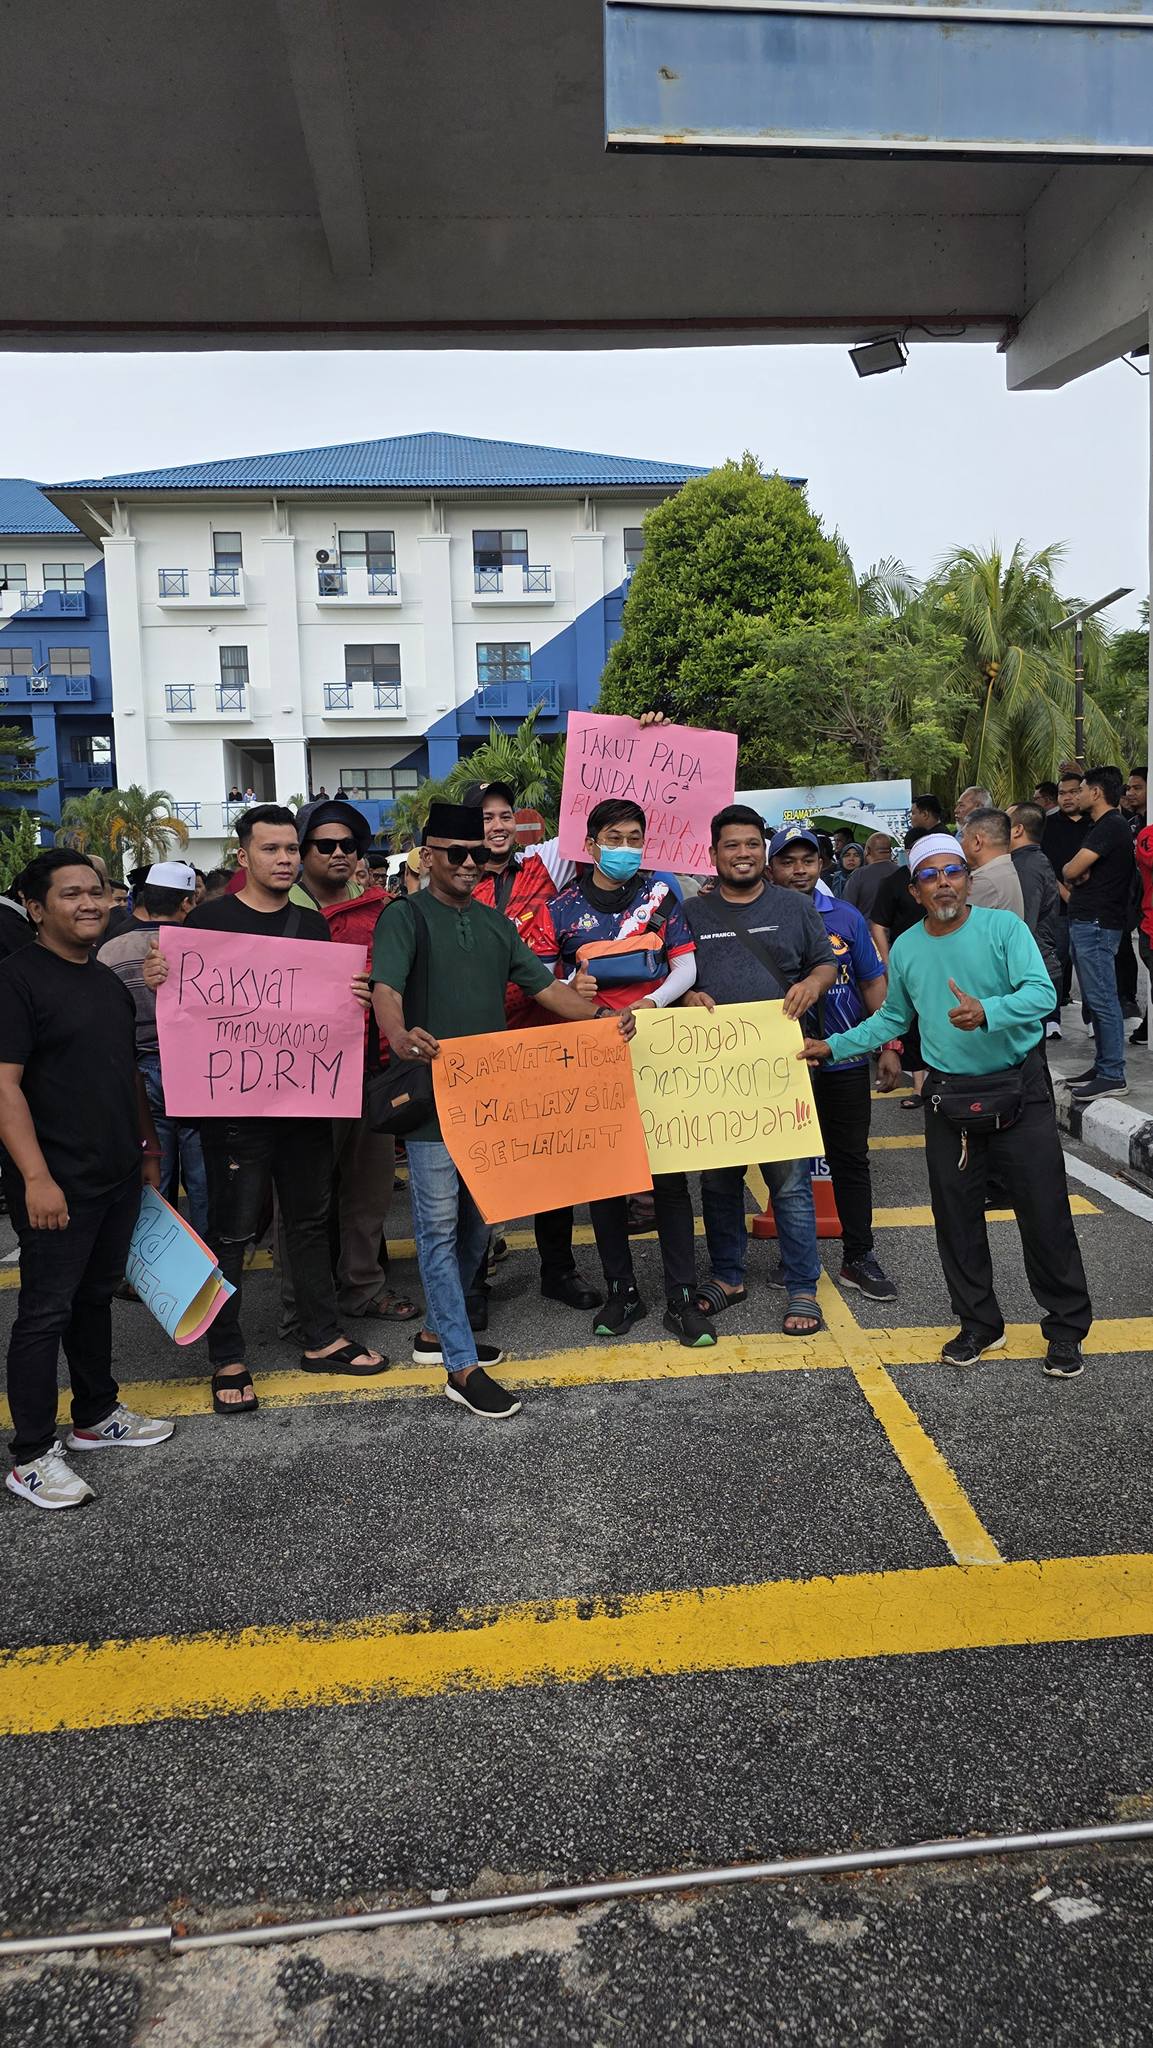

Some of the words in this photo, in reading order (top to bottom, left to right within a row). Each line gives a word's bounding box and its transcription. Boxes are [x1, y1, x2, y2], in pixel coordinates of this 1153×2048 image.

[576, 727, 640, 763] TAKUT
[649, 741, 703, 785] PADA
[783, 808, 813, 821] SELAMAT
[649, 1015, 762, 1063] Jangan
[203, 1049, 344, 1100] P.D.R.M
[468, 1124, 623, 1175] SELAMAT
